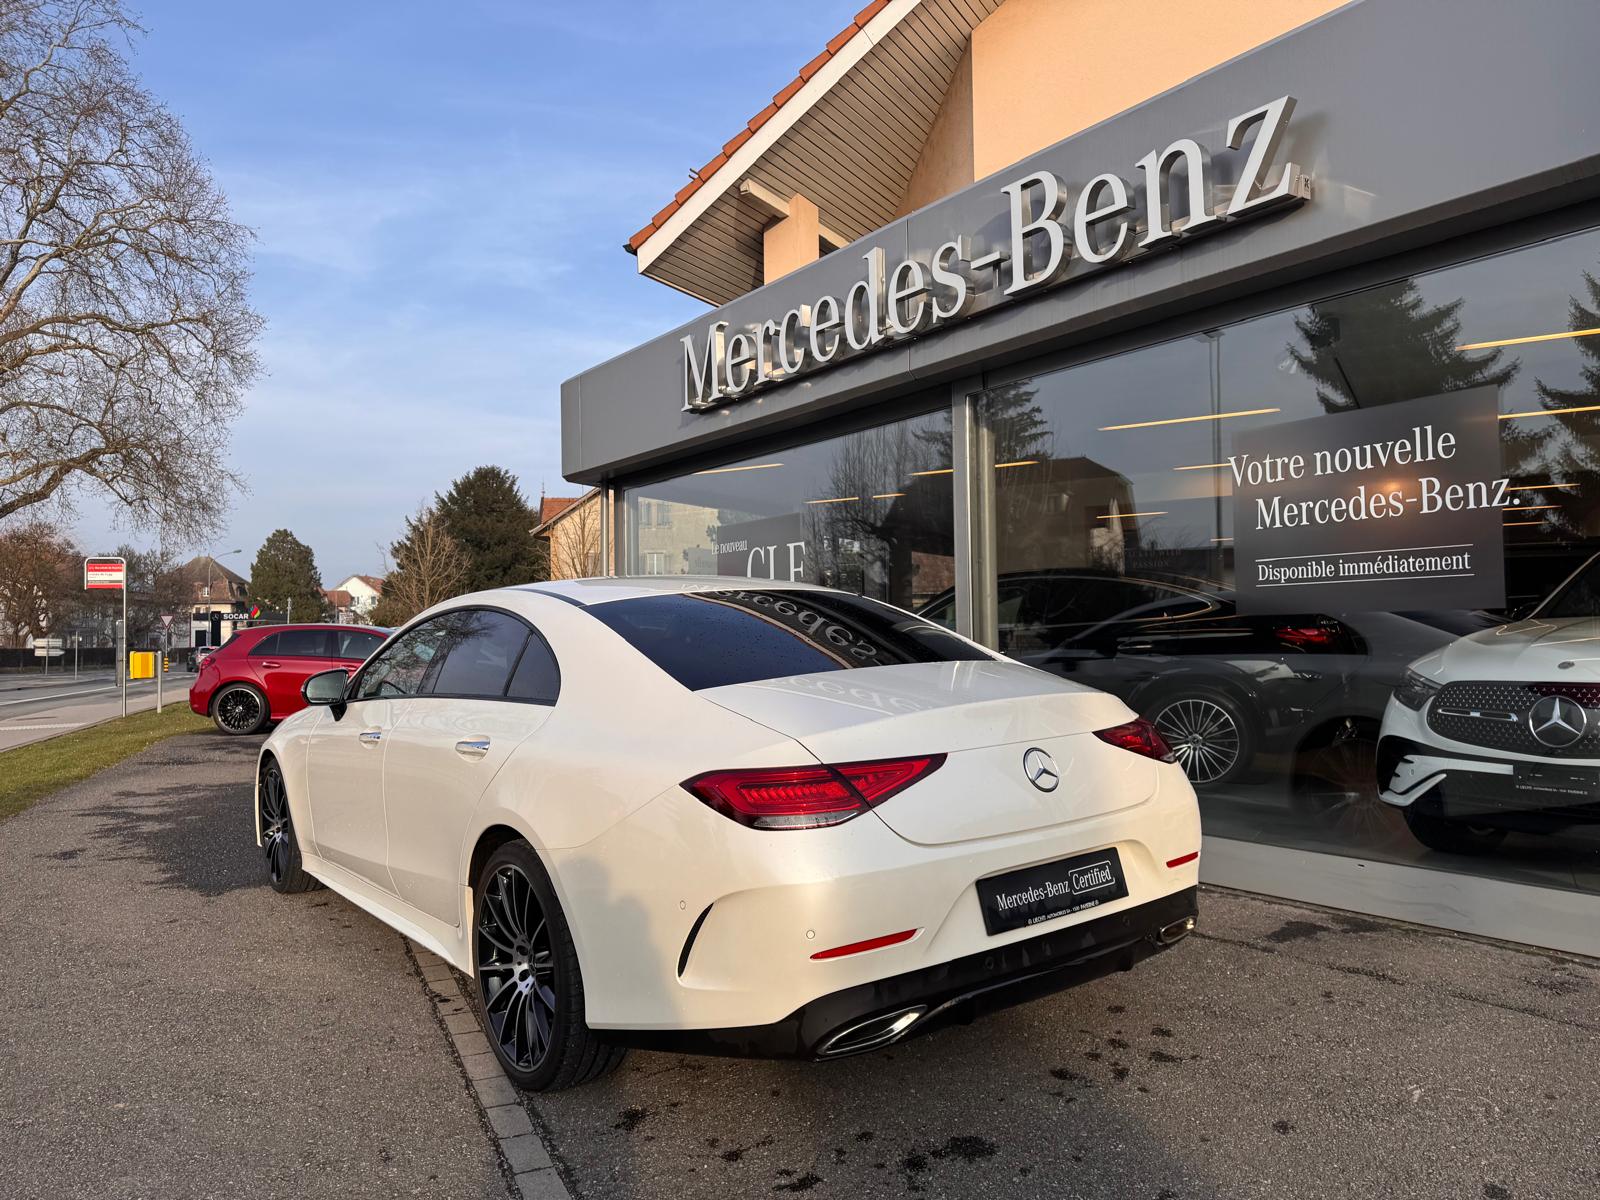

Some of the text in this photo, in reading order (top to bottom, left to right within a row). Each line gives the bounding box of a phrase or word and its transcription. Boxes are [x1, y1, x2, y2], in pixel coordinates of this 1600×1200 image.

[679, 95, 1299, 412] Mercedes-Benz
[1229, 424, 1456, 487] Votre nouvelle
[1255, 477, 1521, 530] Mercedes-Benz.
[711, 539, 748, 555] Le nouveau
[1257, 552, 1471, 583] Disponible immédiatement
[996, 866, 1111, 911] Mercedes-Benz Certified
